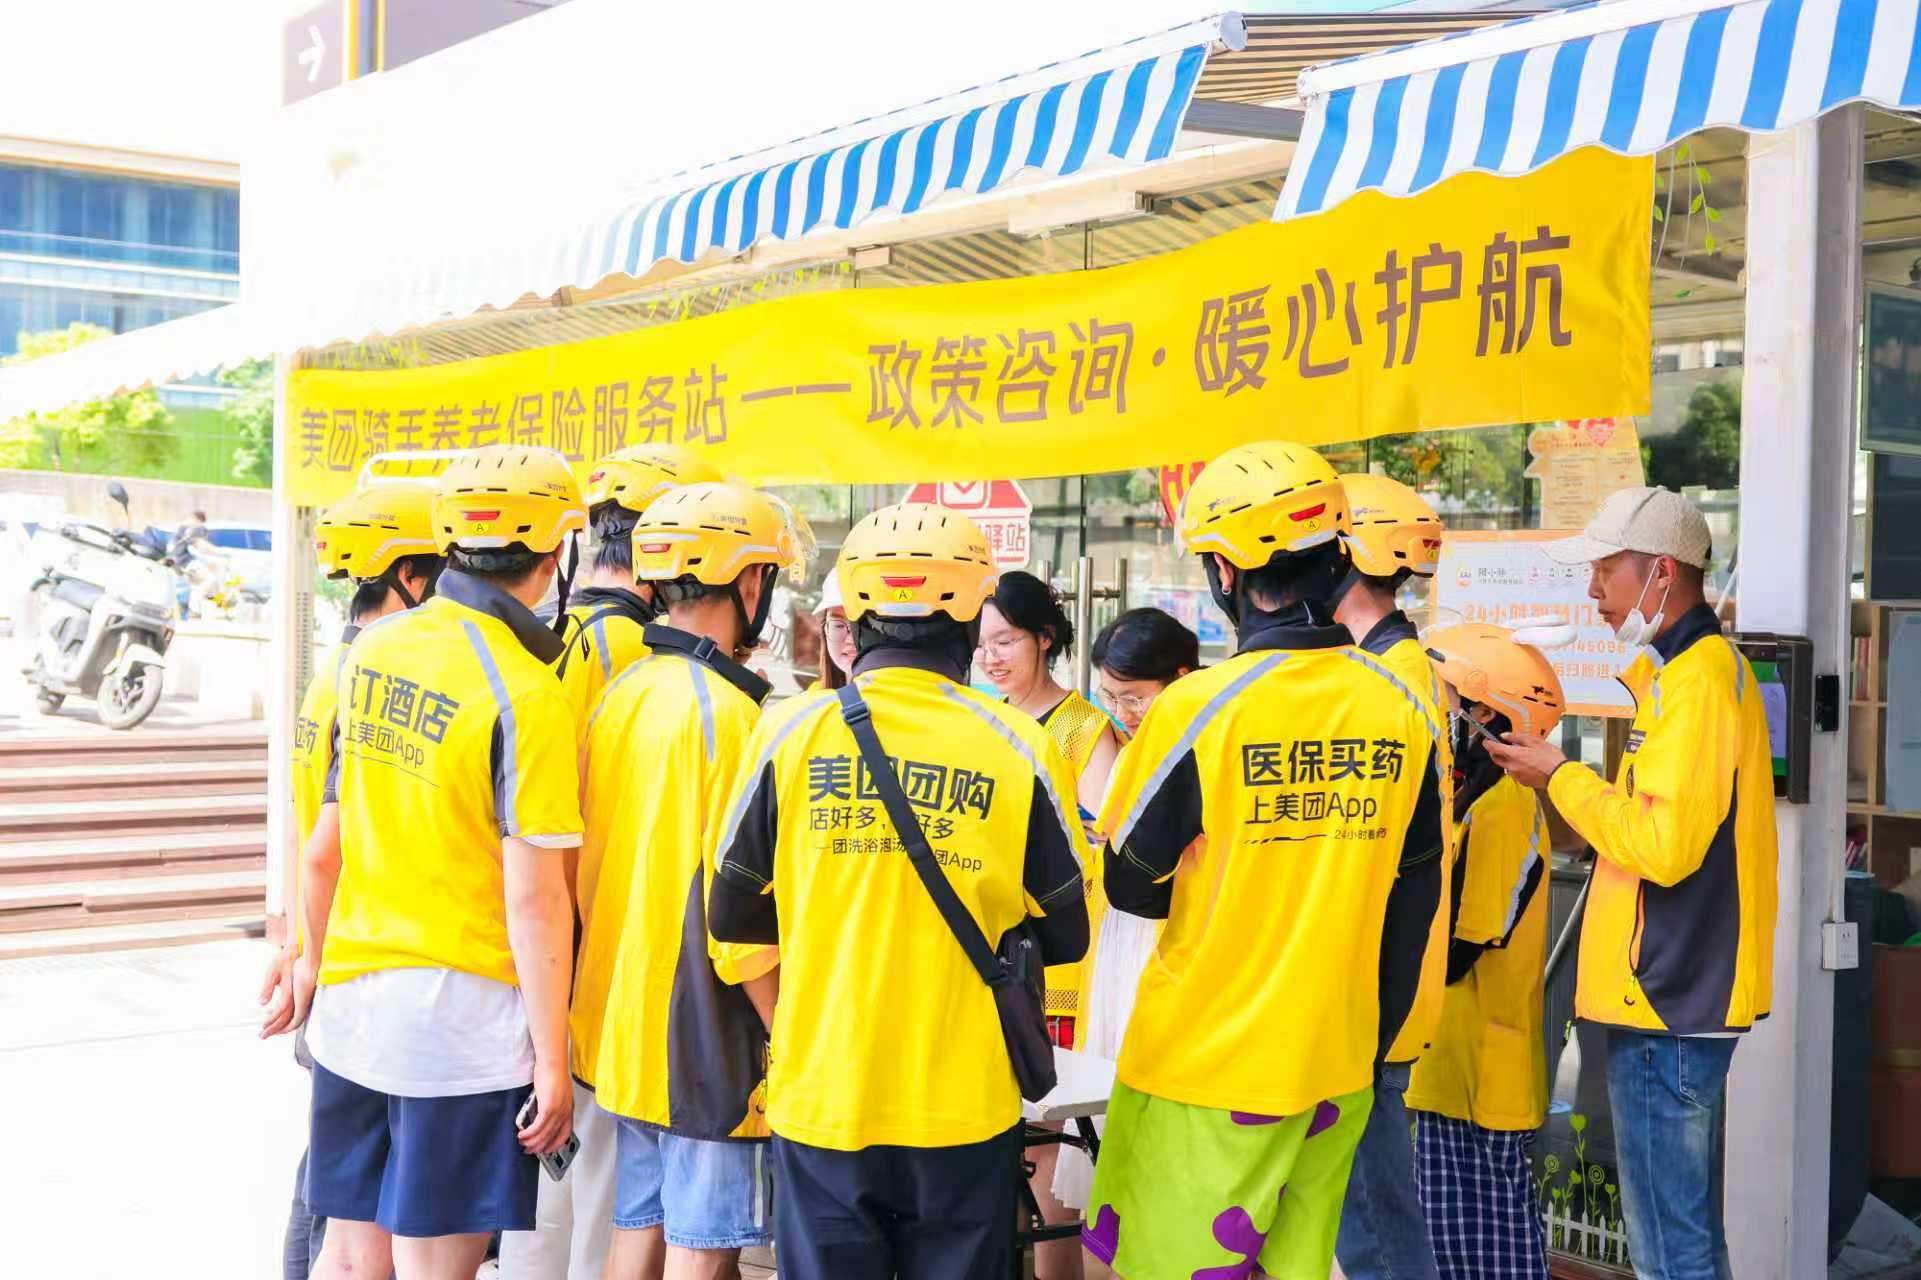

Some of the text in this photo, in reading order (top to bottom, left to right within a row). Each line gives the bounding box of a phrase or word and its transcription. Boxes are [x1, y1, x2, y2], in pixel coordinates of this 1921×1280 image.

[1242, 737, 1406, 787] 医保买药
[1245, 791, 1377, 824] 上美团App
